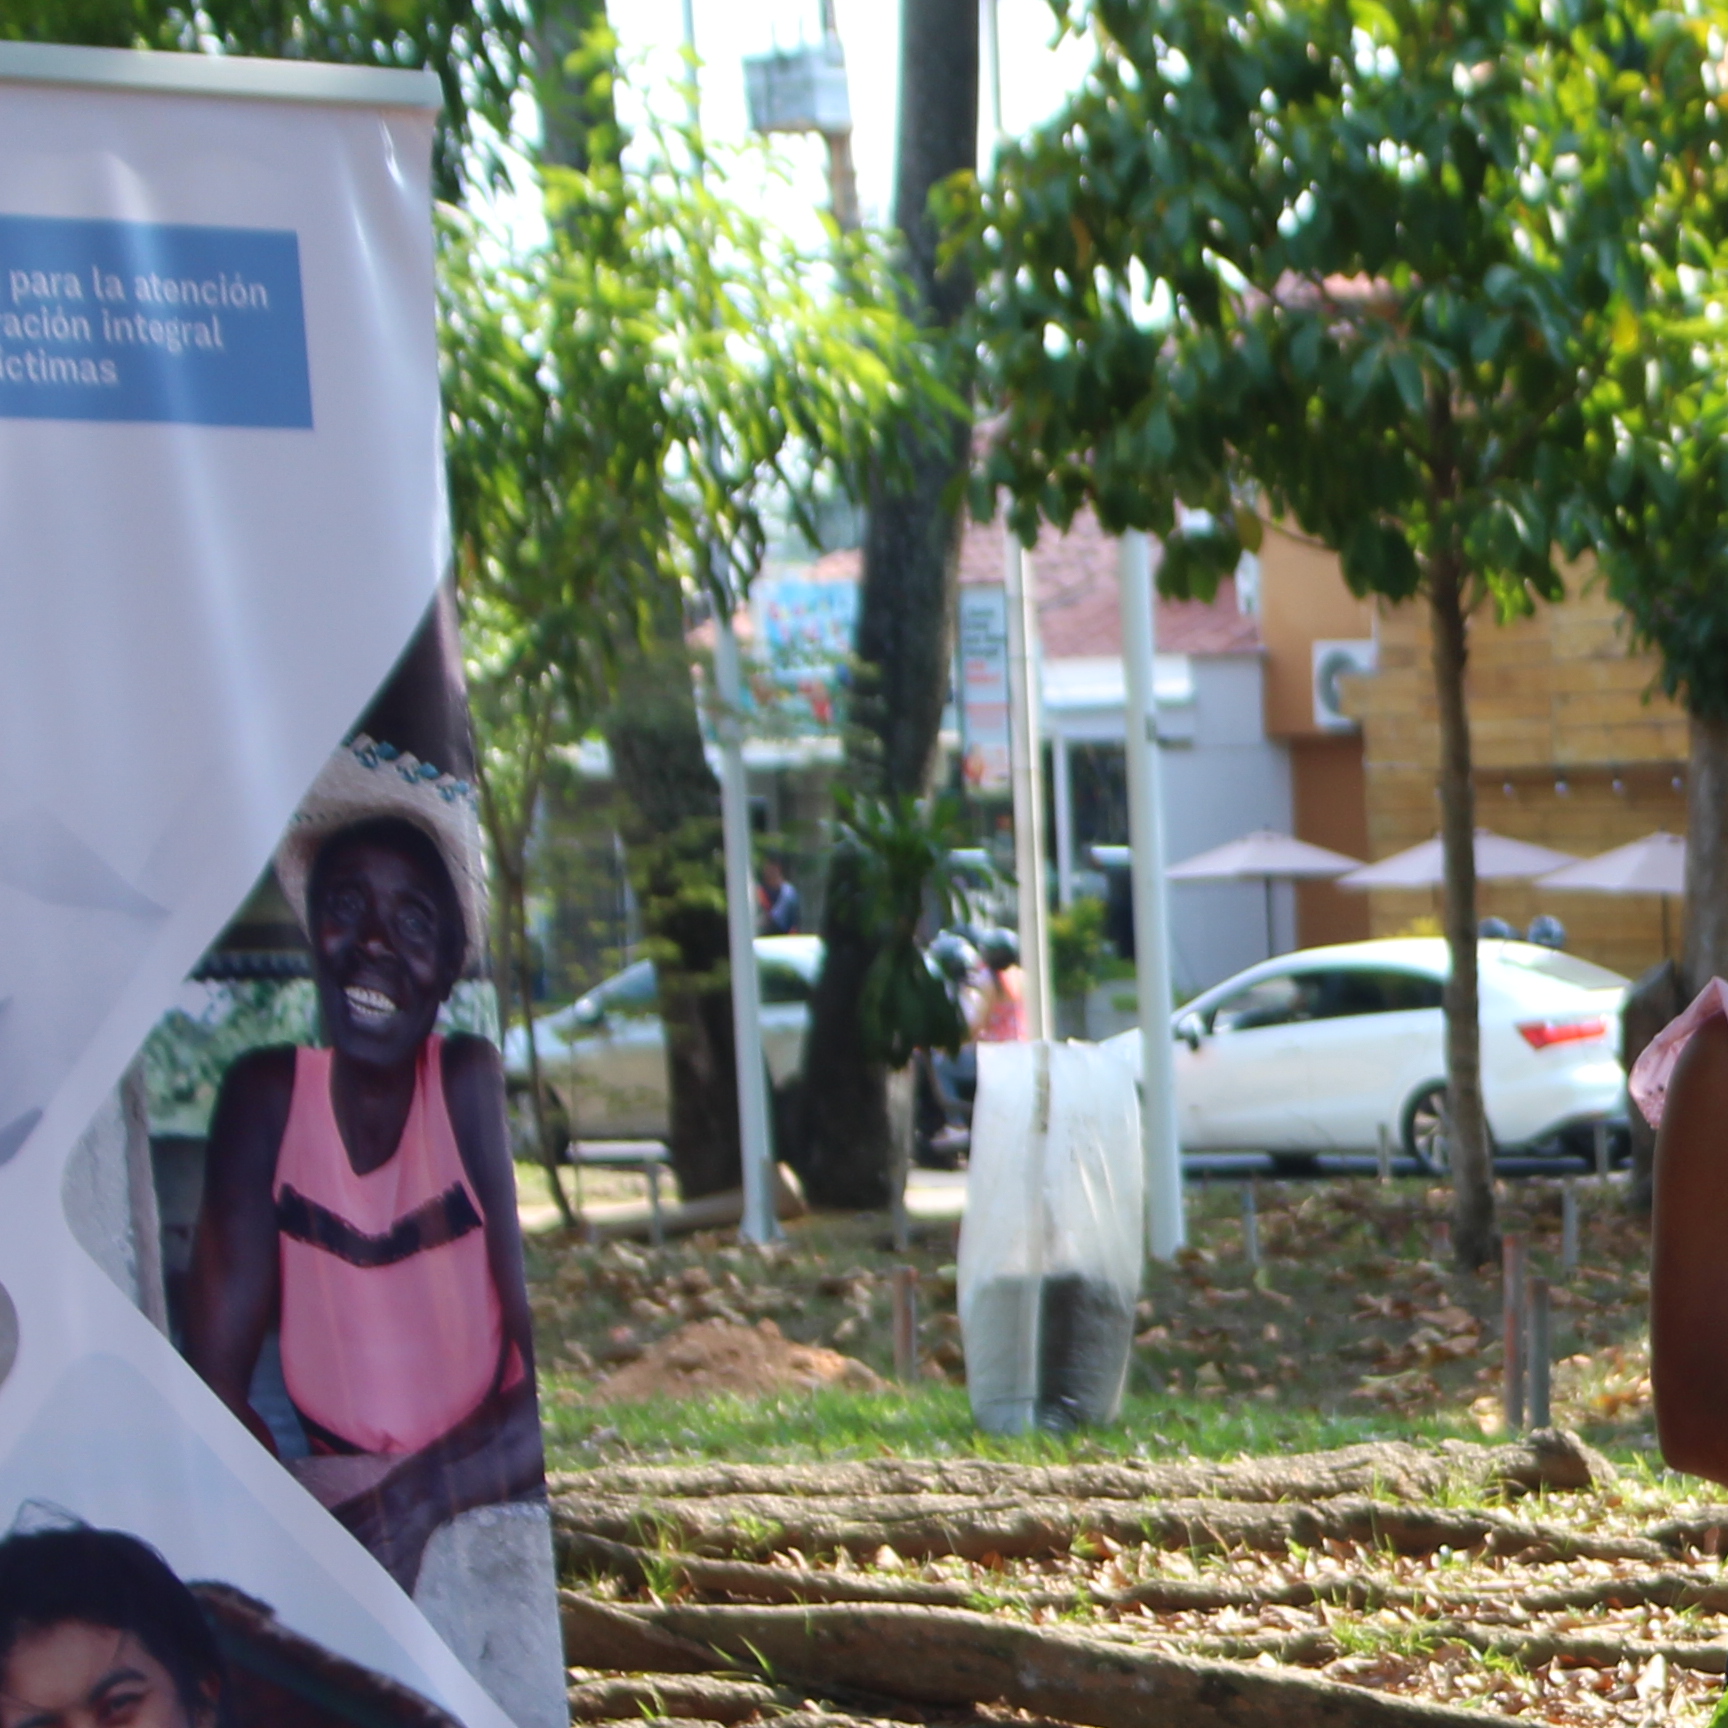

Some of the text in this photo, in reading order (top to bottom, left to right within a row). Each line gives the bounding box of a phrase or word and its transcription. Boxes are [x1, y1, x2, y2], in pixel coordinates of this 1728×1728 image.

[10, 264, 268, 309] para la atención
[102, 307, 224, 353] integral
